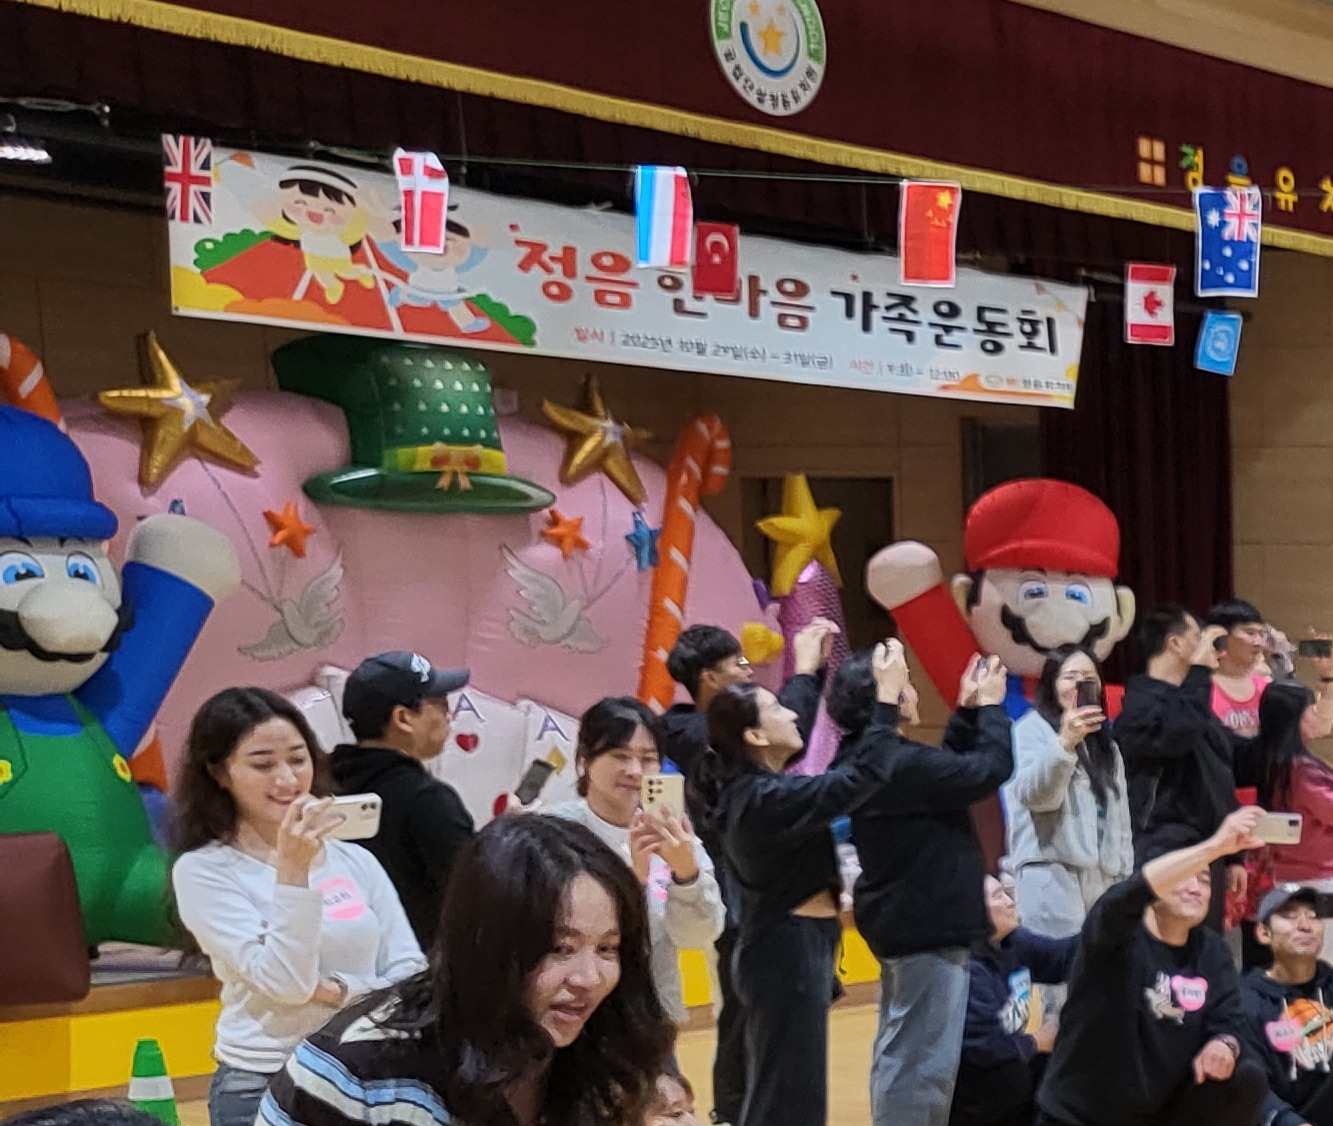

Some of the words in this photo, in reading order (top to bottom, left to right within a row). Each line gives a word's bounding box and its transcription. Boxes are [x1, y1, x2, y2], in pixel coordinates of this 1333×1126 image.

[514, 239, 639, 309] 정음
[830, 289, 1058, 355] 가족운동회
[453, 692, 486, 723] A
[535, 713, 571, 742] A
